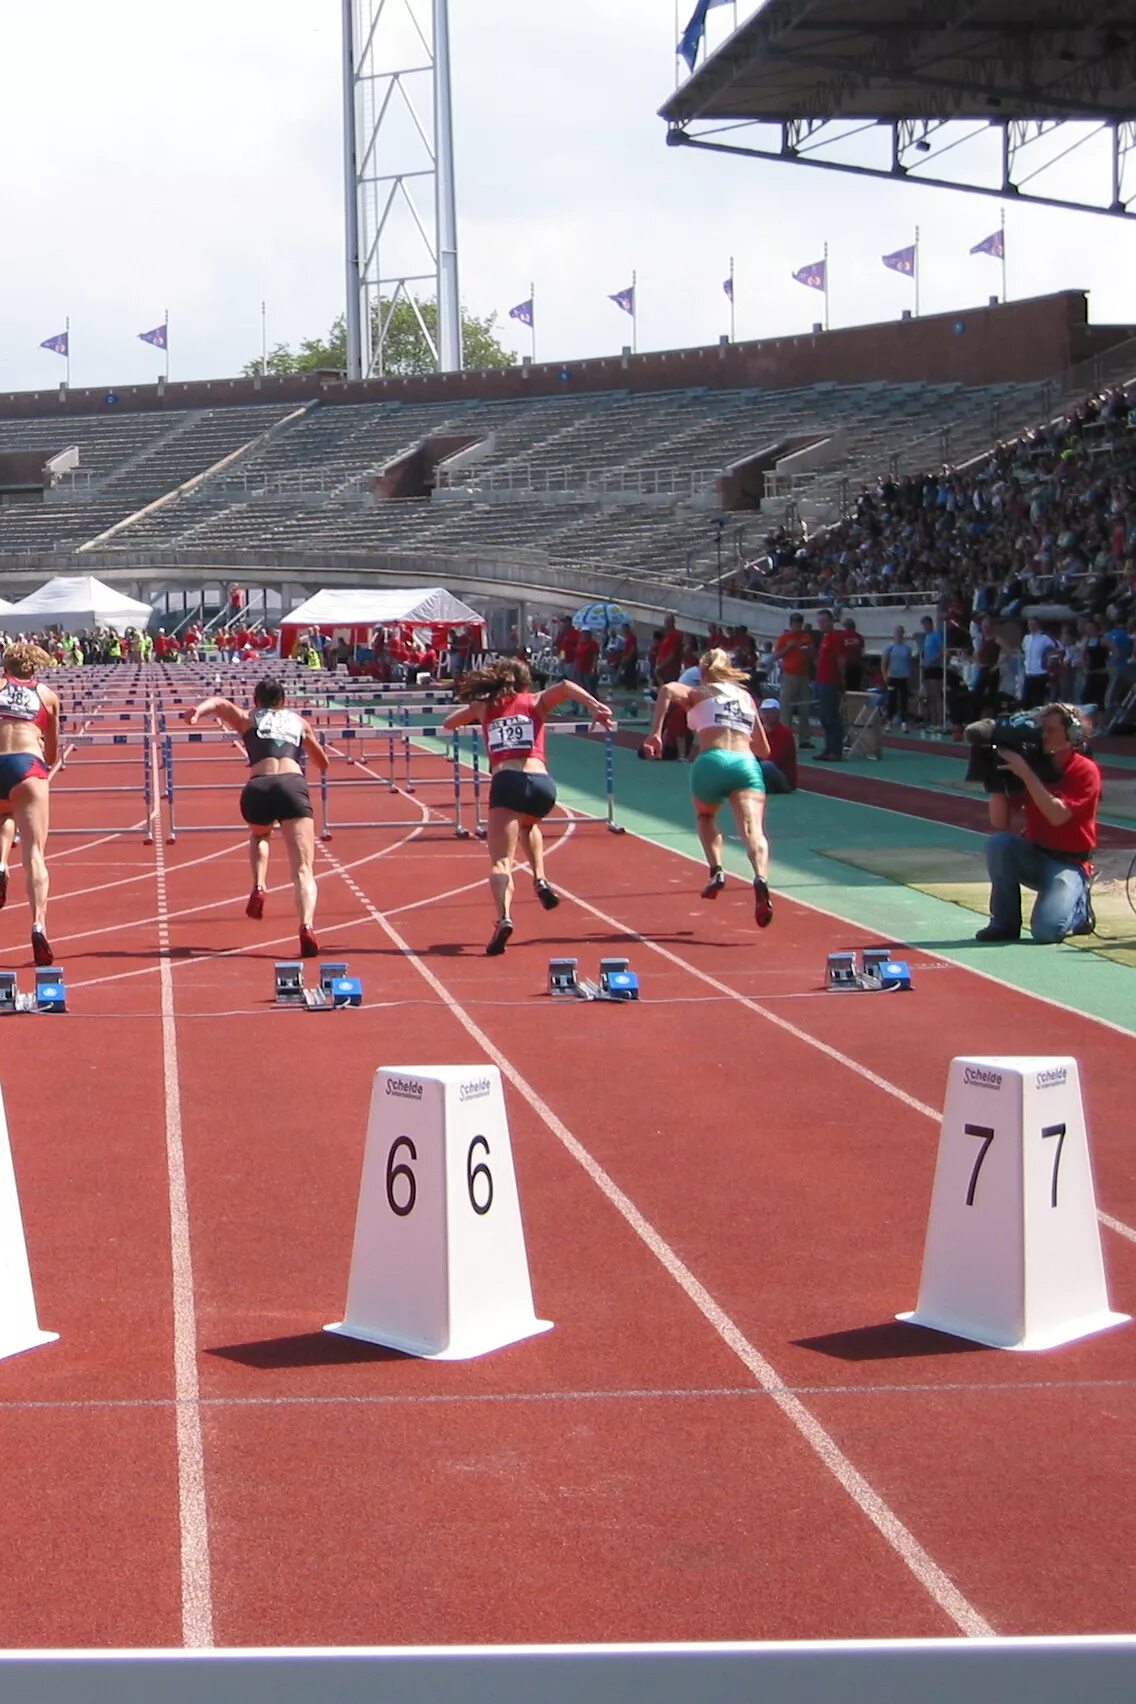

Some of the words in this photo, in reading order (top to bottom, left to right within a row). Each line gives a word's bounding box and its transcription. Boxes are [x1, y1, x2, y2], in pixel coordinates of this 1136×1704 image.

[498, 726, 523, 741] 129
[386, 1136, 417, 1216] 6
[467, 1135, 493, 1215] 6
[964, 1123, 994, 1206] 7
[1041, 1123, 1066, 1208] 7
